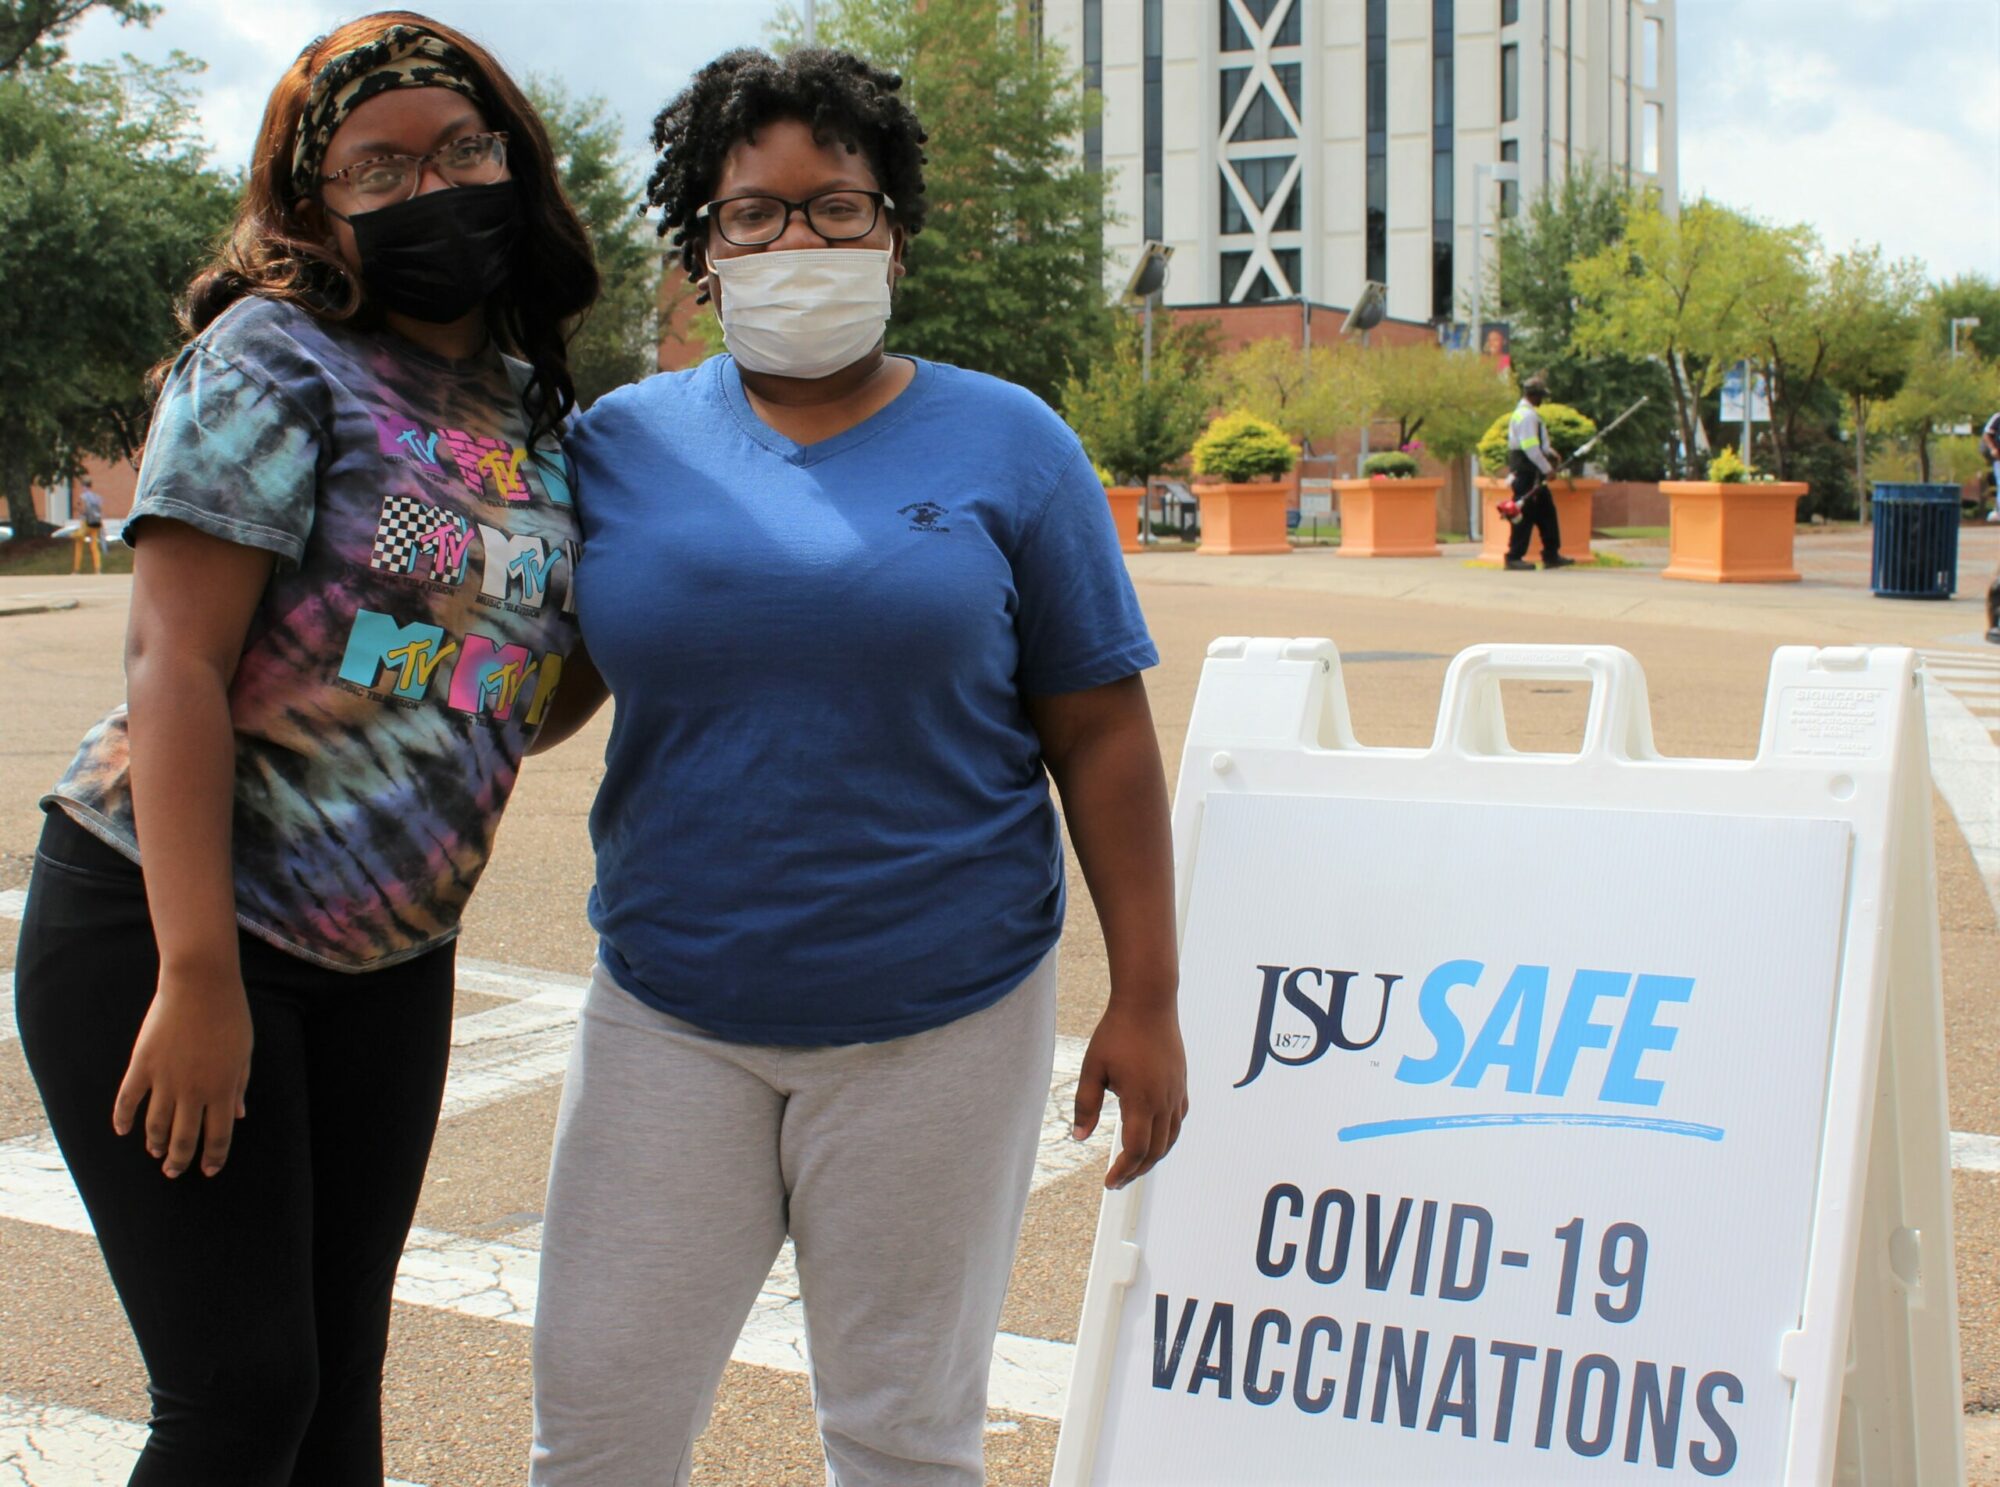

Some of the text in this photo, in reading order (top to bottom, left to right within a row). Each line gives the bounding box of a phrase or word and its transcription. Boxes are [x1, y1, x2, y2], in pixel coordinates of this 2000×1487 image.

[437, 427, 531, 505] MTV
[370, 495, 476, 586] MTV
[477, 522, 563, 609] MTV
[475, 594, 540, 619] MUSIC TELEVISION
[337, 607, 458, 702] MTV
[447, 632, 539, 721] MTV
[1234, 959, 1696, 1107] JSU SAFE
[1274, 1032, 1311, 1050] 1877
[1255, 1183, 1648, 1324] COVID-19
[1152, 1293, 1744, 1477] VACCINATIONS
